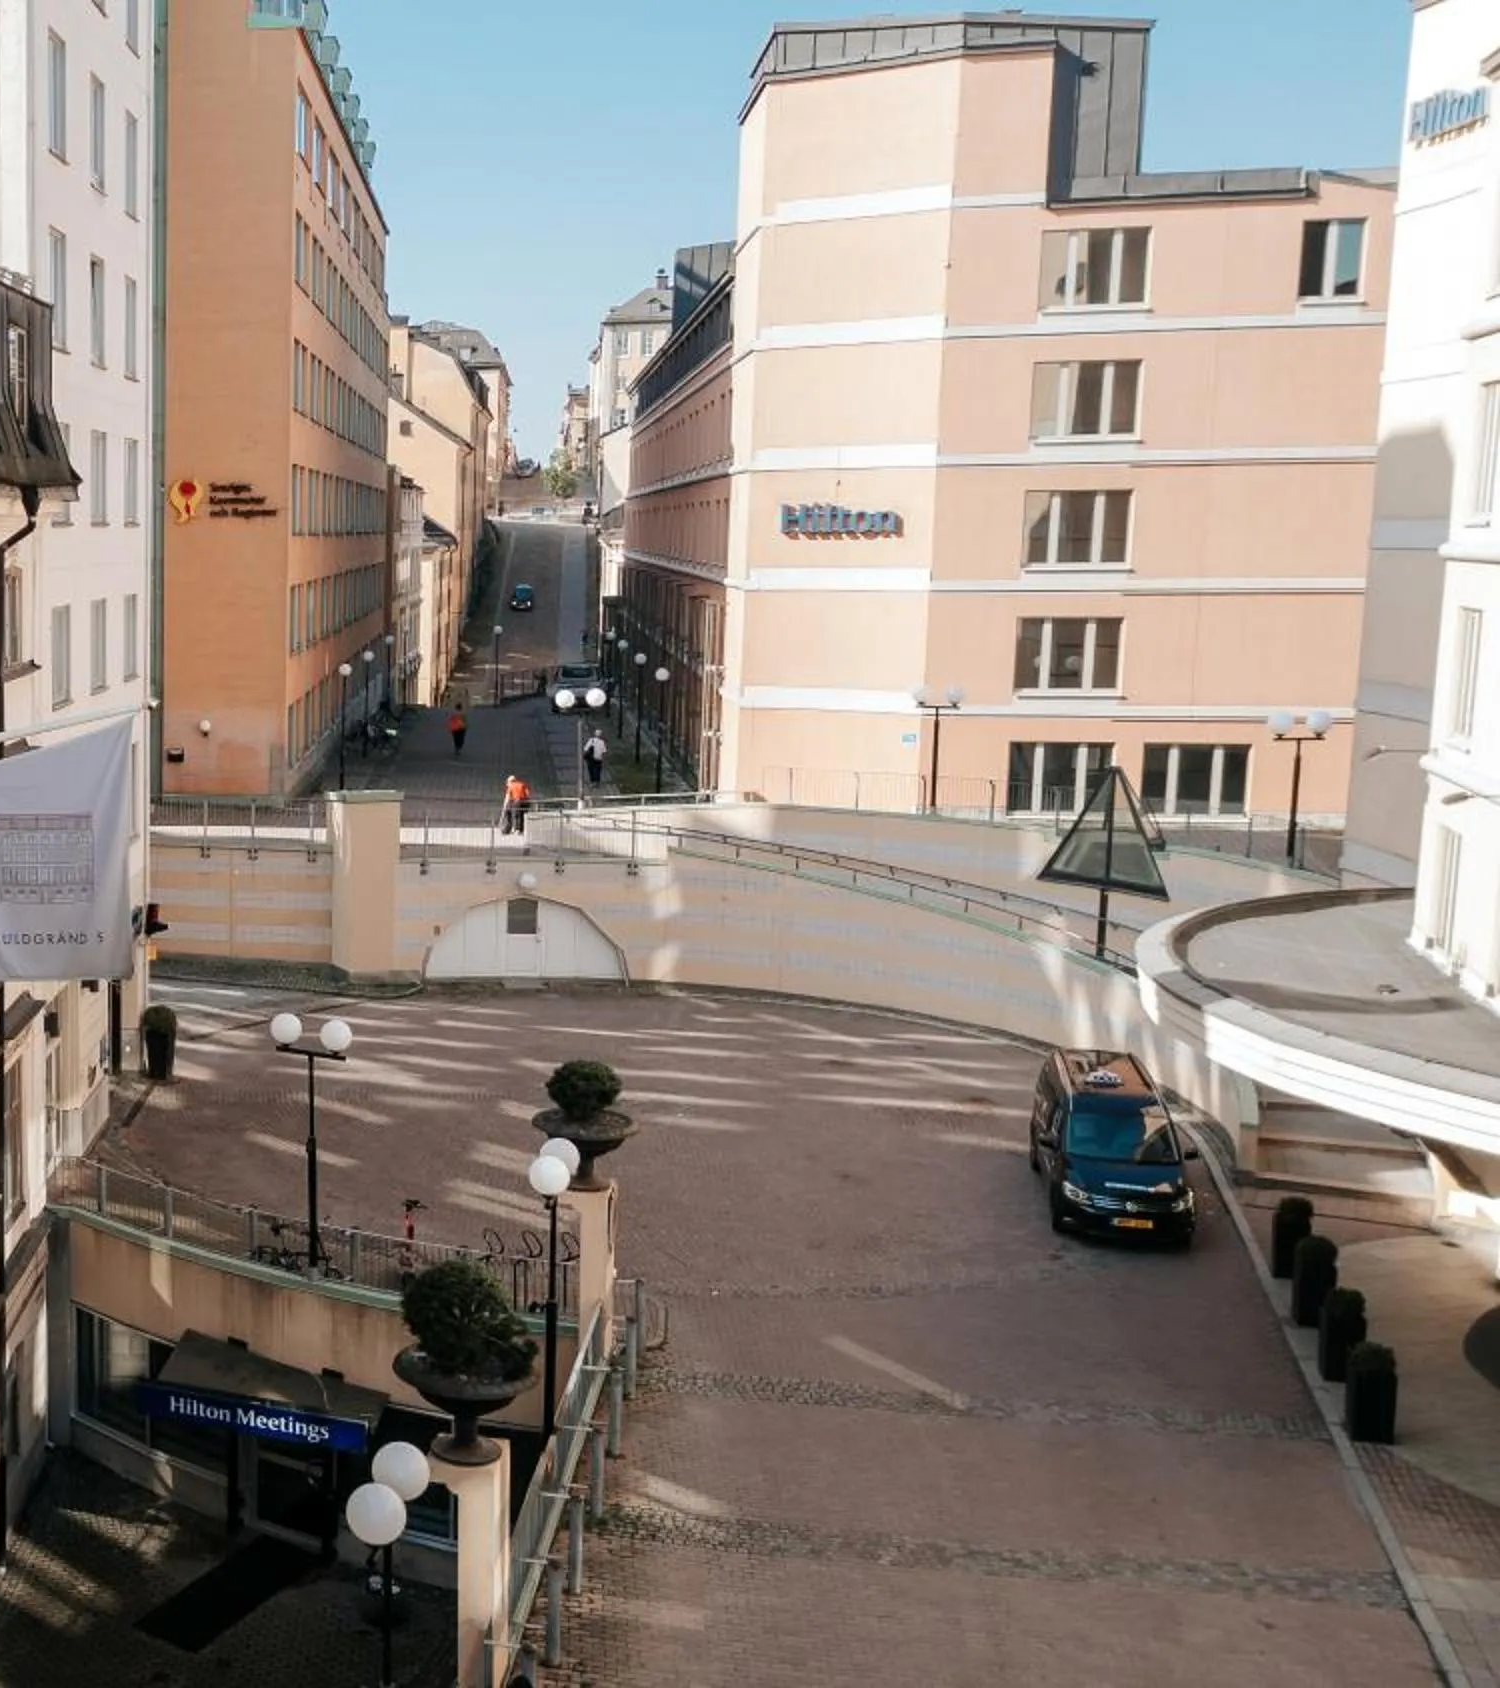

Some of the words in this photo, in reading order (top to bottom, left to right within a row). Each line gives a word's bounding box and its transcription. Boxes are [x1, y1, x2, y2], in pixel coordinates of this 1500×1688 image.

[1408, 87, 1489, 143] Hilton
[780, 503, 904, 537] Hilton
[169, 1395, 231, 1423] Hilton
[236, 1407, 330, 1443] Meetings
